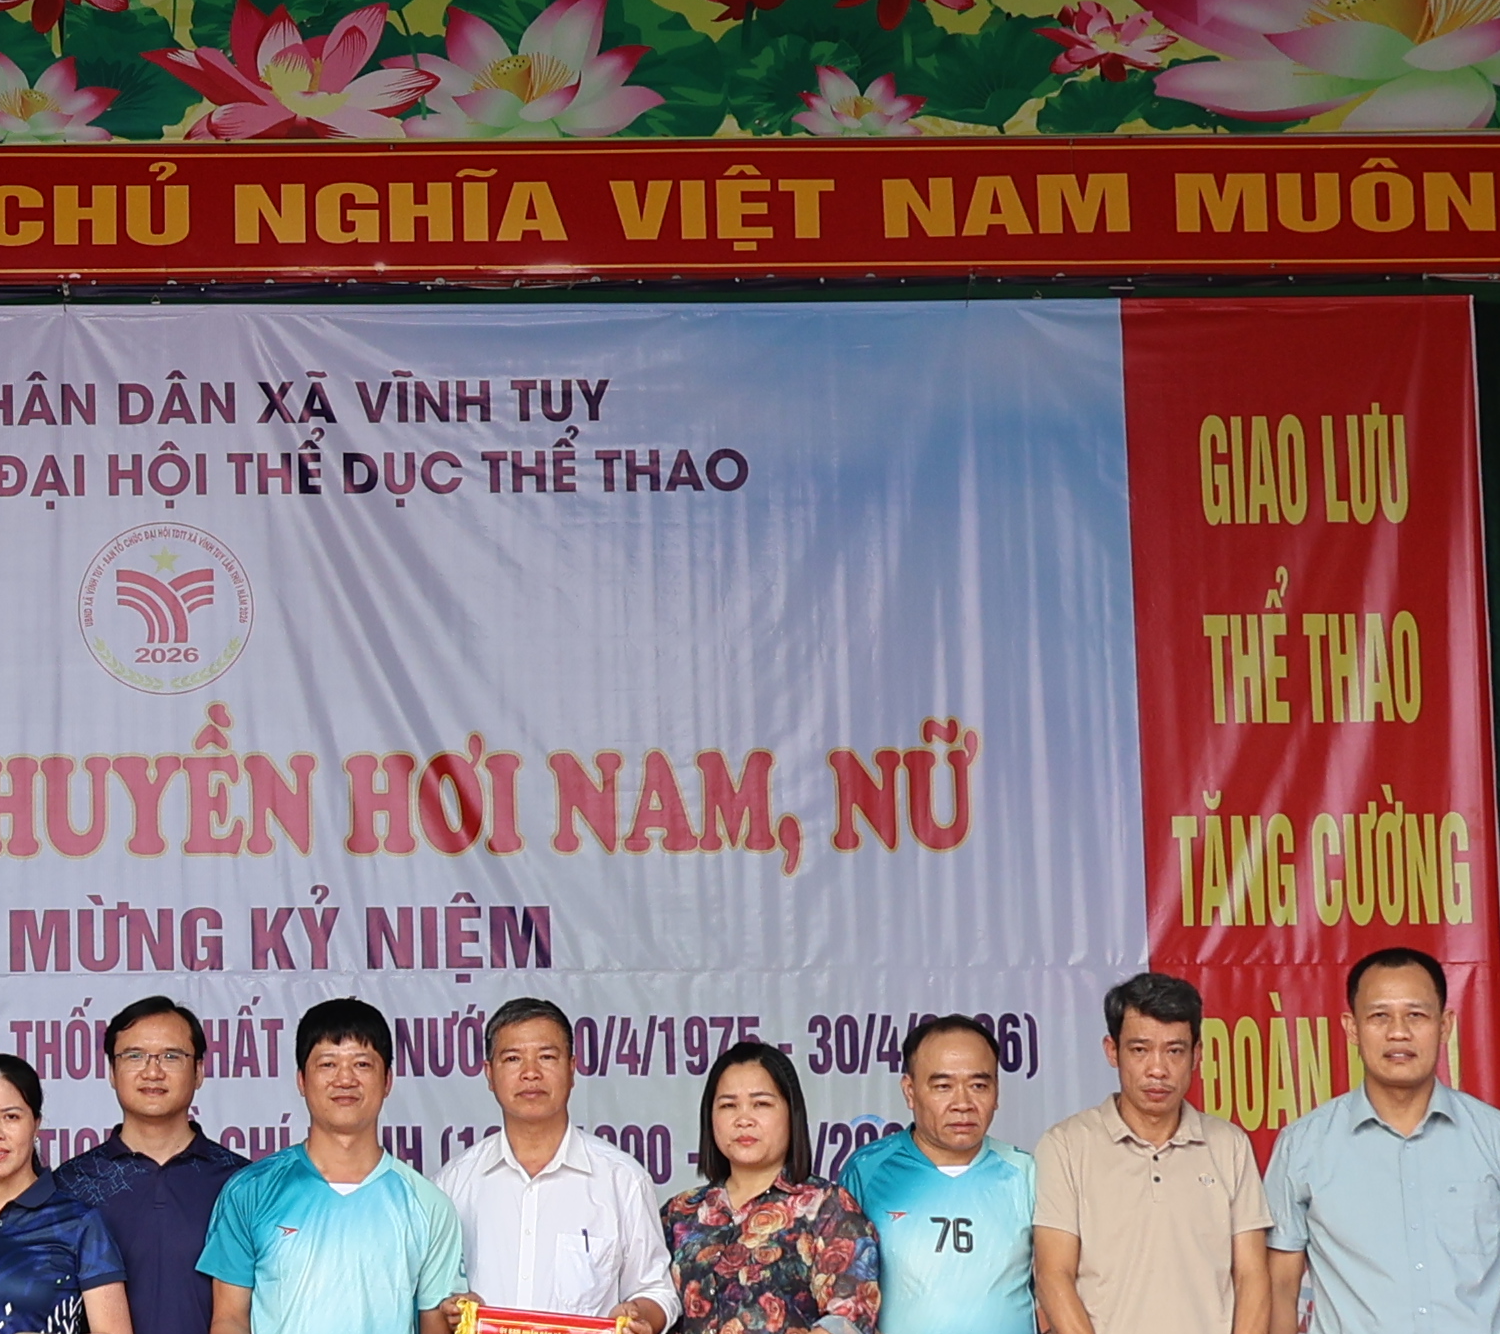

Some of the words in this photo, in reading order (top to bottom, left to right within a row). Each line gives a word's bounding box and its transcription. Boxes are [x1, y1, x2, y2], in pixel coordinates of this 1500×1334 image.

[235, 169, 568, 243] NGHĨA
[610, 165, 834, 250] VIỆT
[882, 173, 1130, 238] NAM
[1175, 158, 1495, 232] MUÔN
[118, 370, 235, 424] DÂN
[258, 371, 337, 433] XÃ
[355, 370, 491, 423] VĨNH
[511, 380, 609, 433] TUY
[108, 441, 207, 508] HỘI
[227, 427, 325, 494] THỂ
[343, 451, 462, 507] DỤC
[481, 425, 579, 493] THỂ
[595, 449, 748, 492] THAO
[1200, 415, 1308, 524] GIAO
[1322, 403, 1409, 523] LƯU
[135, 648, 199, 663] 2026
[1203, 565, 1292, 724] THỂ
[1302, 611, 1422, 722] THAO
[346, 734, 521, 856] HƠI
[549, 751, 800, 874] NAM,
[829, 722, 974, 850] NỮ
[1172, 790, 1298, 927] TĂNG
[1312, 784, 1472, 927] CƯỜNG
[9, 895, 223, 972] MỪNG
[251, 885, 338, 970] KỶ
[364, 892, 551, 983] NIỆM
[10, 997, 107, 1079] THỐ
[203, 996, 284, 1078] HẤT
[395, 1004, 486, 1077] NƯỚ
[1200, 993, 1332, 1129] ĐOÀN
[930, 1217, 973, 1253] 76
